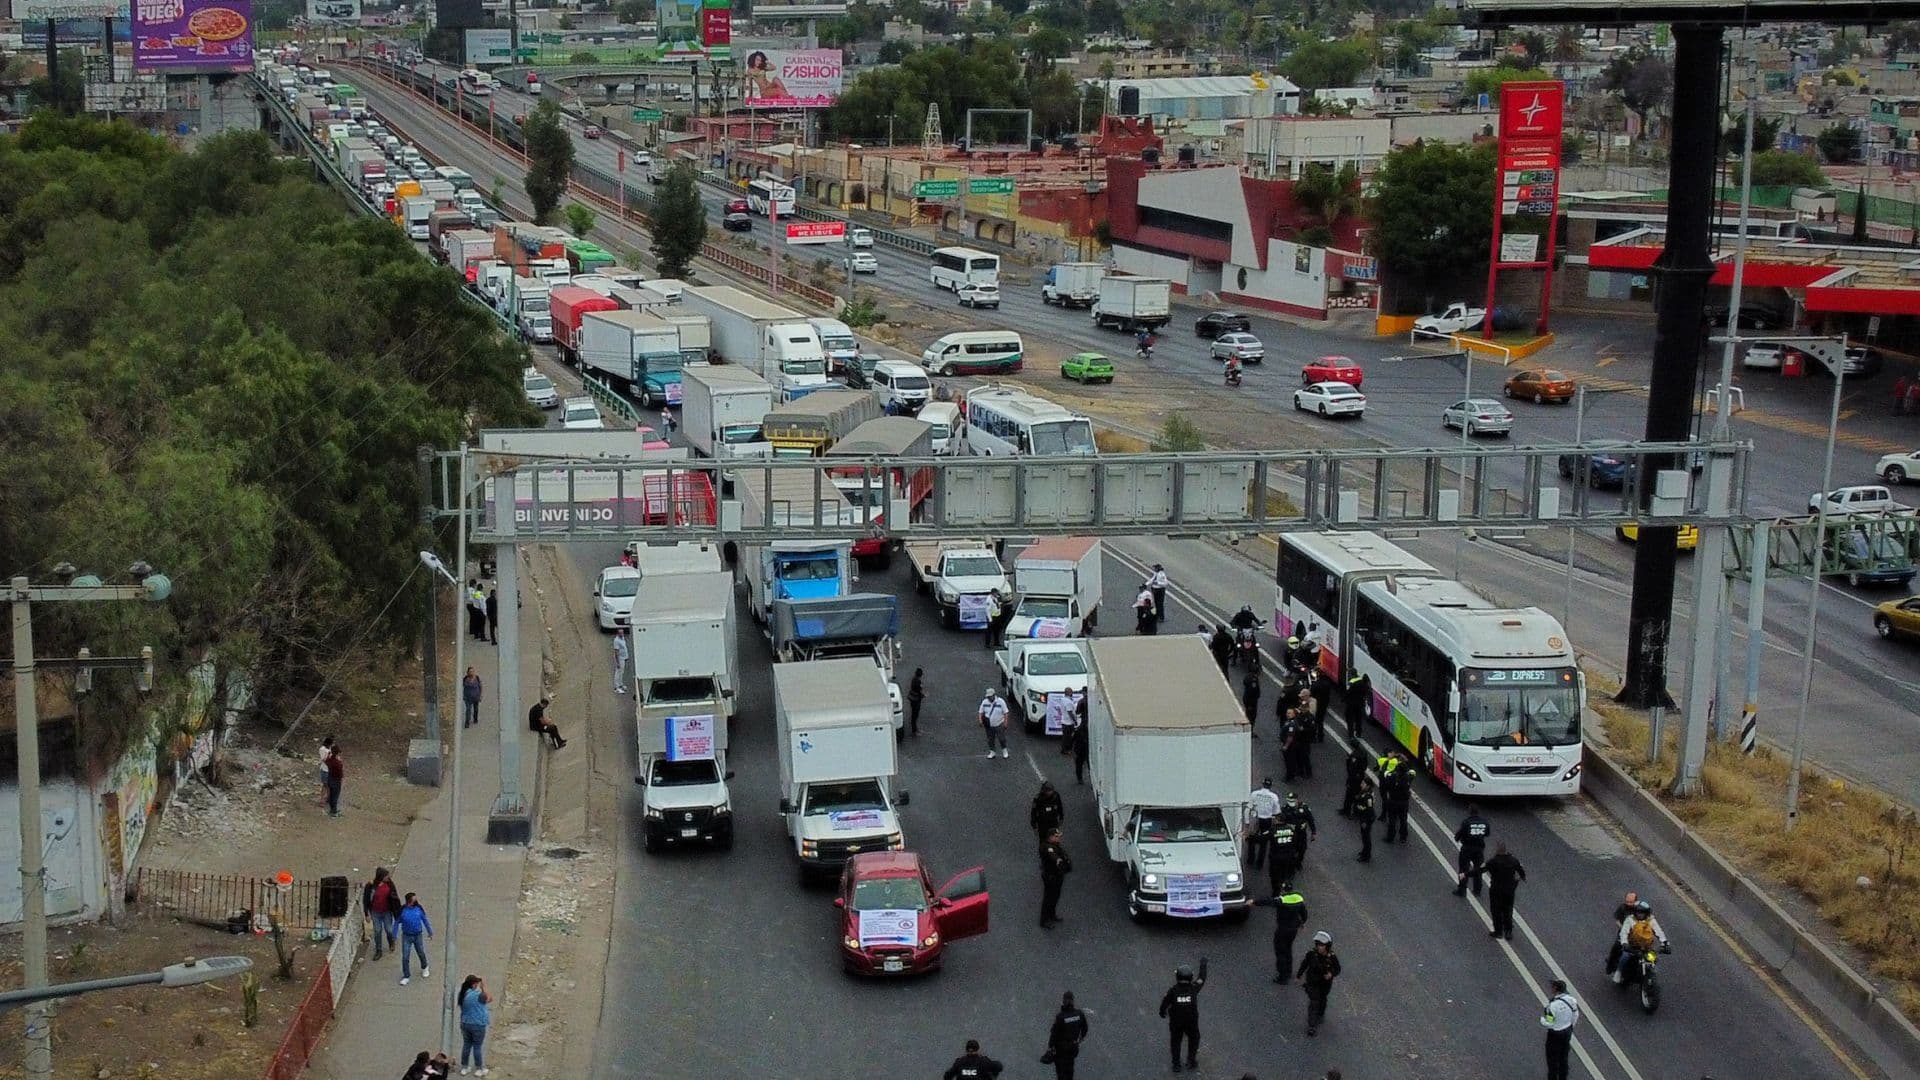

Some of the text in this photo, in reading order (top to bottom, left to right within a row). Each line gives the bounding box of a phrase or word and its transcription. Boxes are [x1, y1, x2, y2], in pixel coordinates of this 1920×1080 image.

[785, 56, 826, 64] CARNIVAL
[782, 66, 841, 78] FASHION
[1511, 670, 1545, 680] EXPRESS
